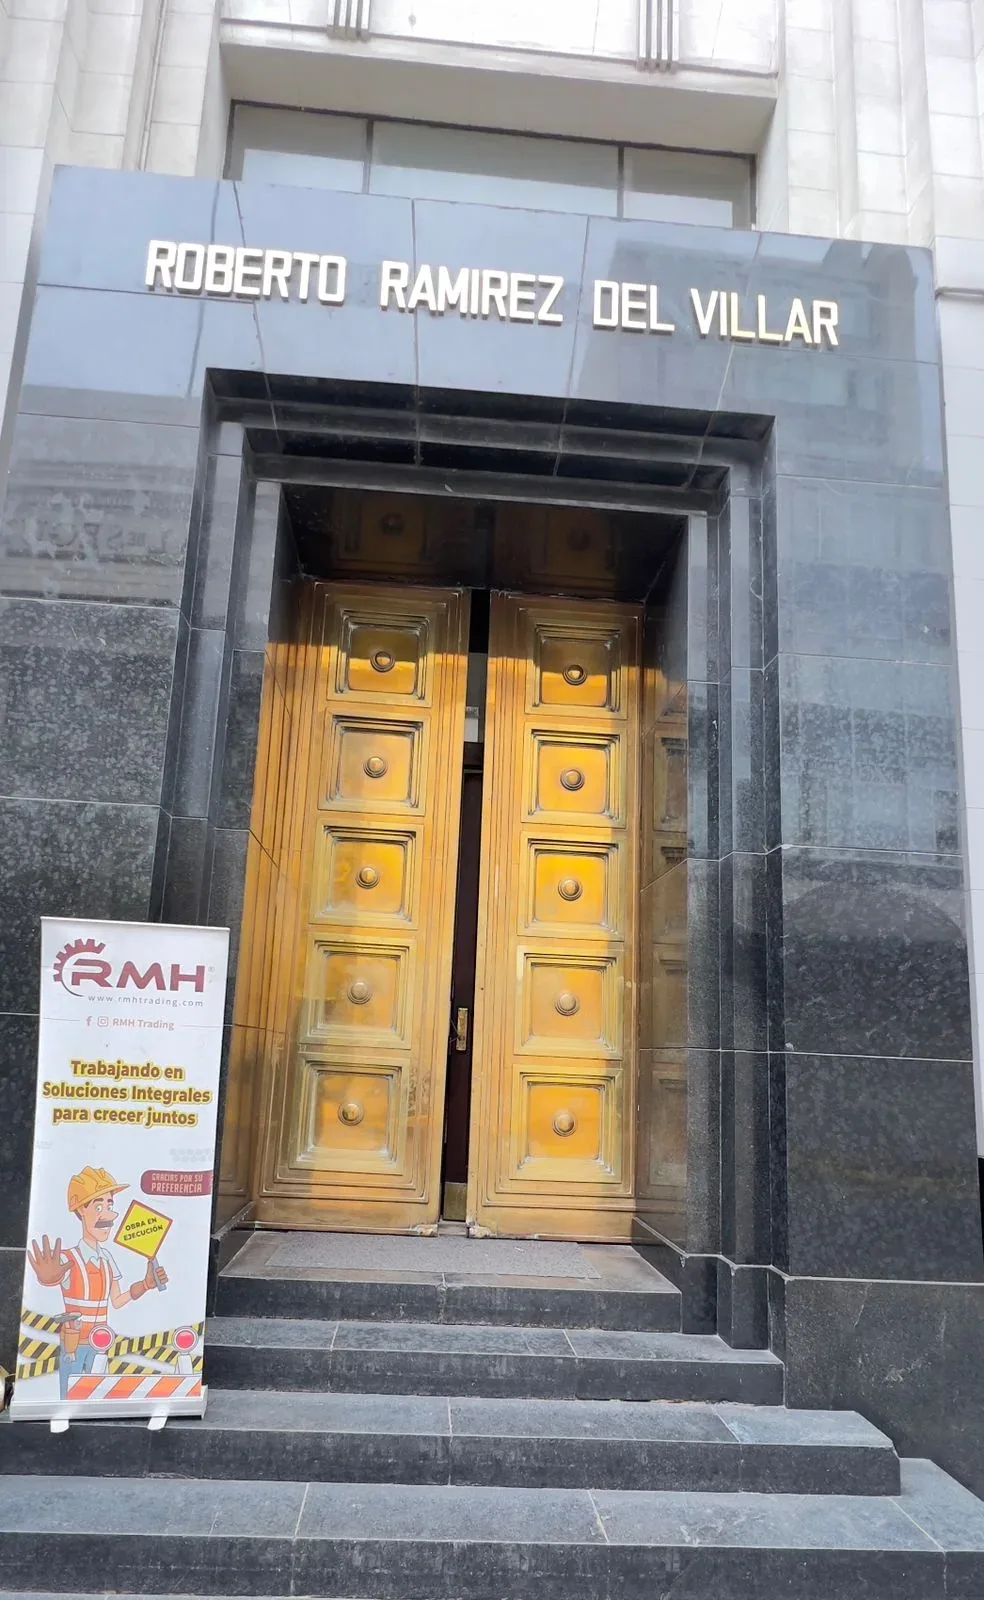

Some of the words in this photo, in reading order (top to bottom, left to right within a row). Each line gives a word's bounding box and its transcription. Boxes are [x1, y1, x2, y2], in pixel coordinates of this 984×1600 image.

[145, 240, 346, 304] ROBERTO
[380, 260, 564, 325] RAMIREZ
[593, 279, 675, 333] DEL
[690, 287, 839, 347] VILLAR
[71, 958, 205, 993] RMH
[88, 994, 204, 1008] www.rmhtrading.com
[112, 1018, 135, 1028] RMH
[138, 1019, 175, 1031] Trading
[71, 1060, 160, 1080] Trabajando
[164, 1065, 184, 1079] en
[43, 1081, 128, 1099] Soluciones
[131, 1085, 211, 1104] Integrales
[52, 1107, 89, 1125] para
[93, 1108, 143, 1122] crecer
[145, 1108, 197, 1127] juntos
[151, 1182, 202, 1194] PREFERENCIA
[123, 1225, 163, 1241] EJECUCIÓN
[125, 1220, 146, 1232] OBRA
